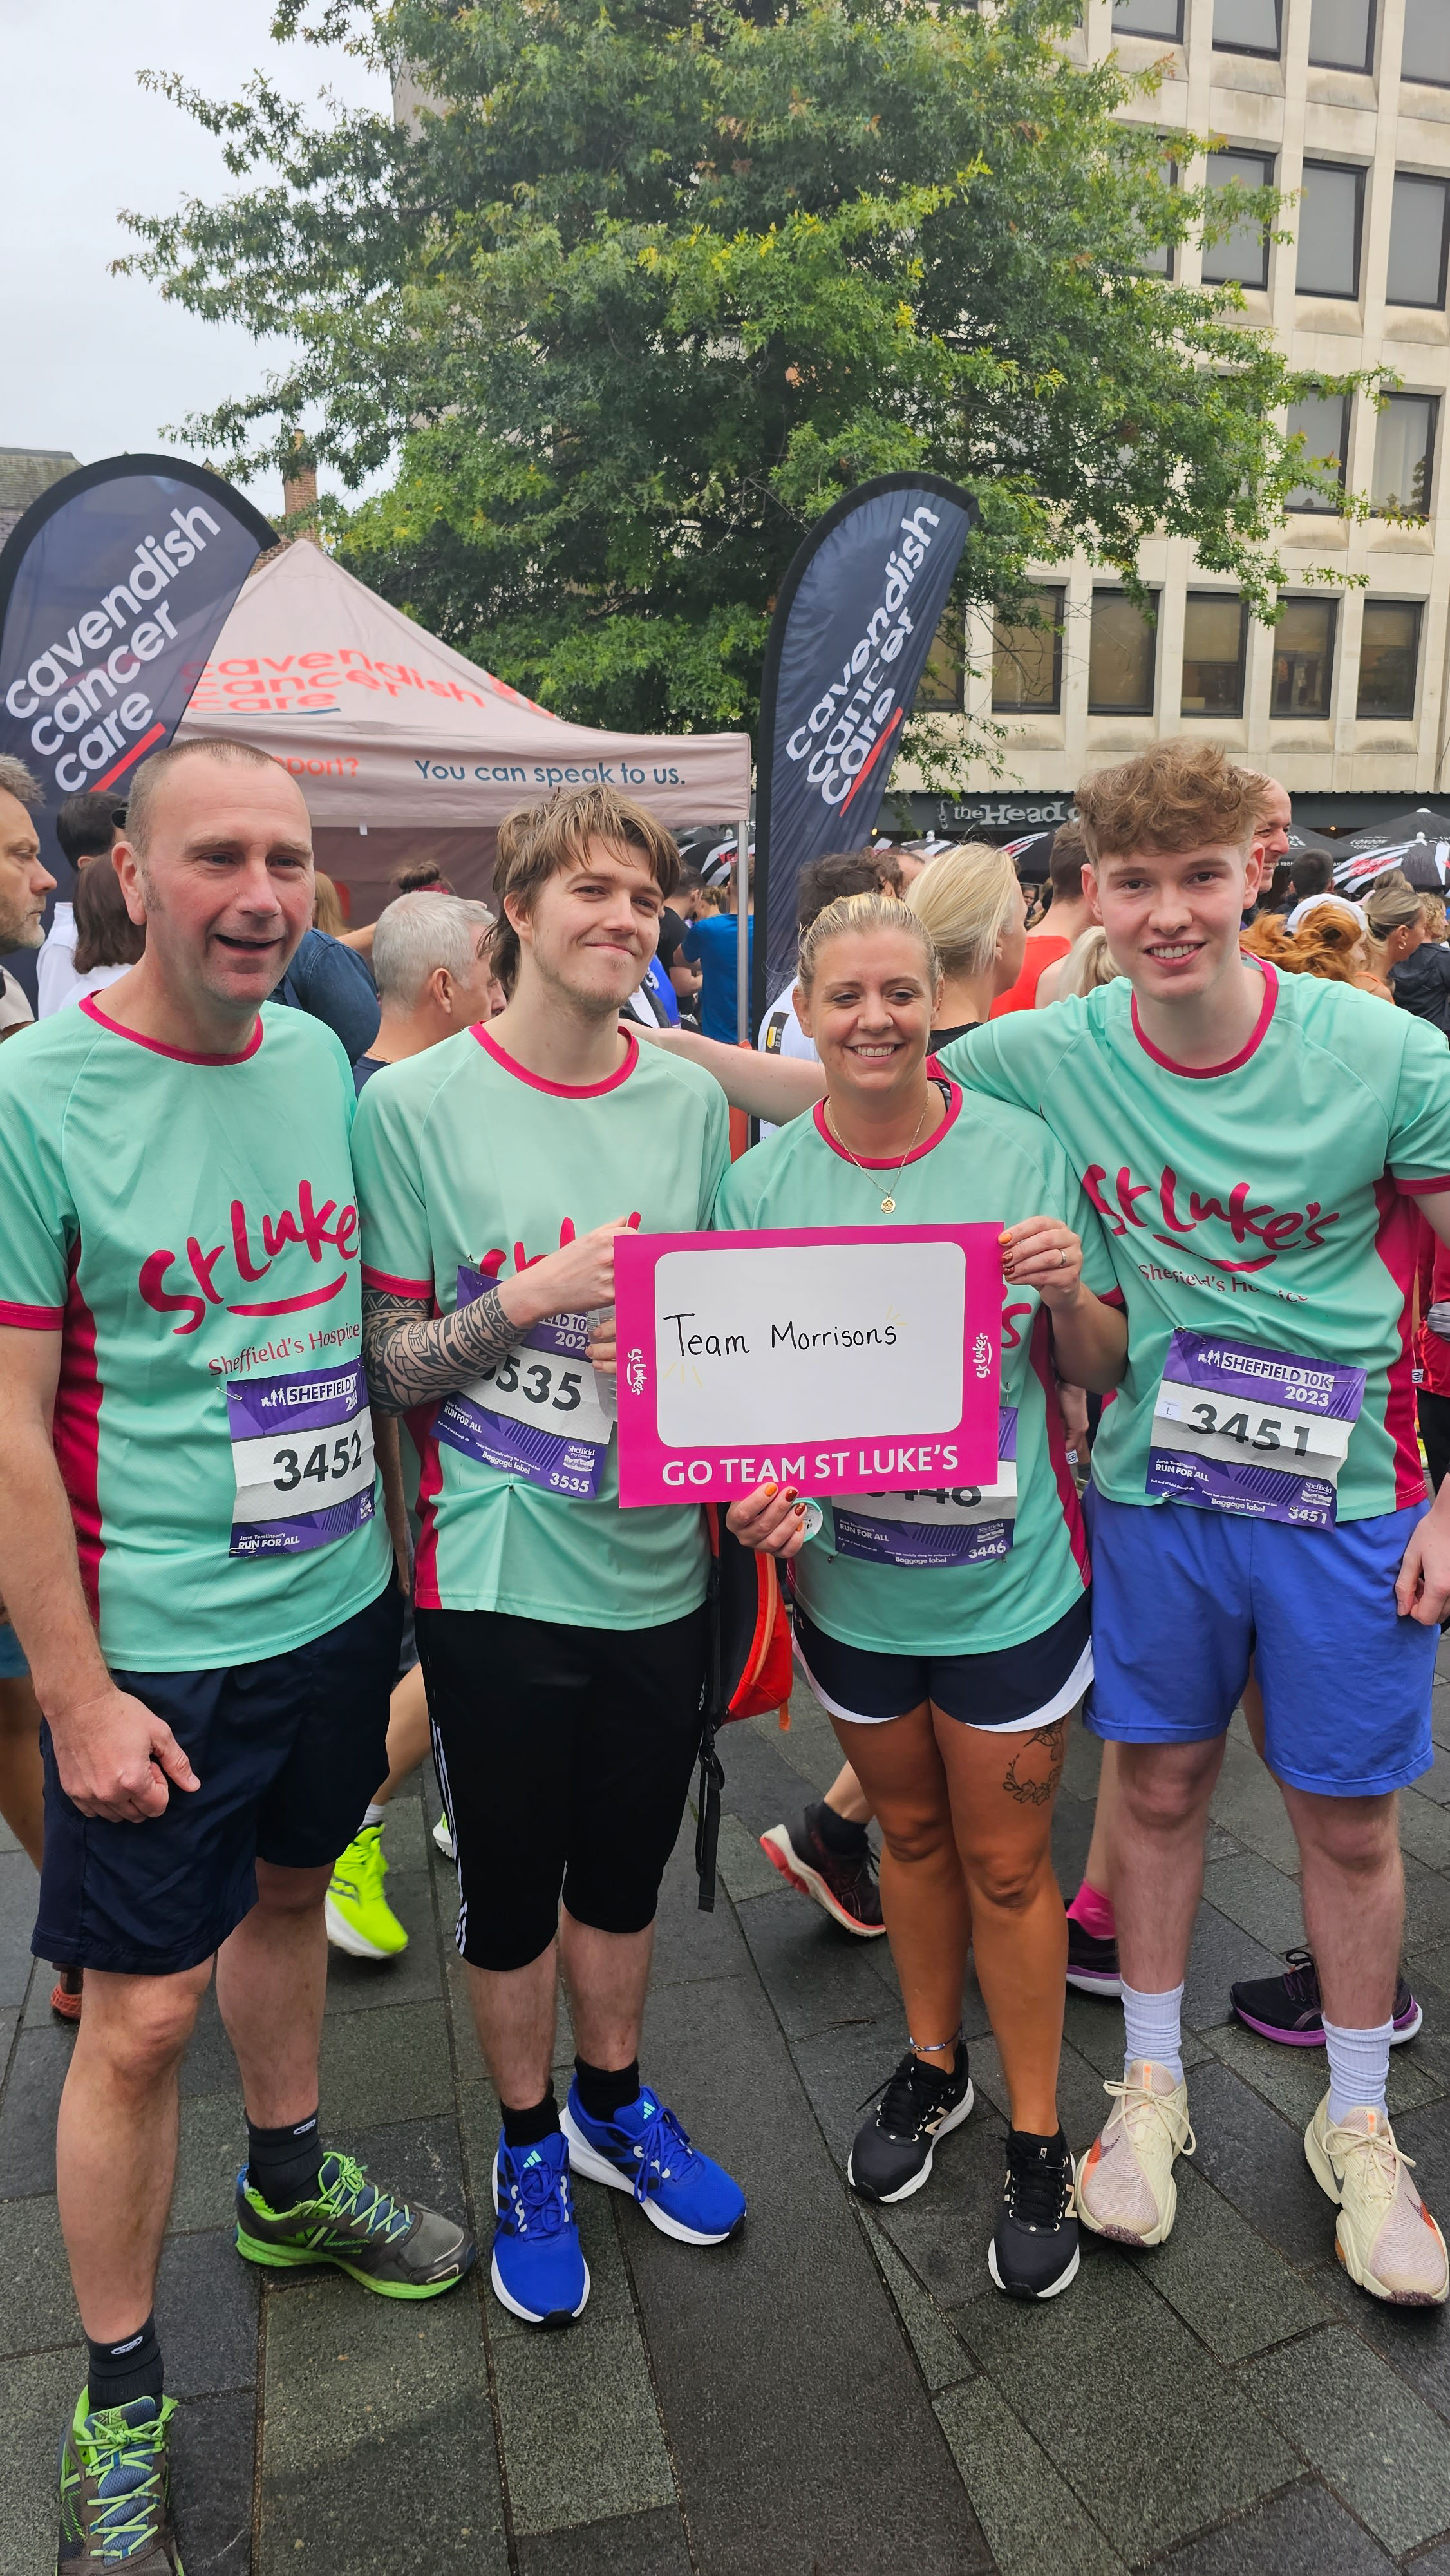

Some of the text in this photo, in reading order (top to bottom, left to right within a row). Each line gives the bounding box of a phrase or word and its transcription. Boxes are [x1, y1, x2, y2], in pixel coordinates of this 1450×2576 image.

[6, 506, 221, 718] cavendish
[786, 506, 940, 761] cavendish
[31, 600, 178, 755] cancer
[182, 648, 485, 708] cavendish
[183, 668, 400, 697] cancer
[187, 692, 337, 711] care
[807, 606, 914, 783] cancer
[55, 692, 153, 791] care
[822, 688, 896, 805] care
[414, 760, 686, 788] You can speak to us.
[954, 806, 984, 820] the
[979, 801, 1066, 825] Head
[1160, 1164, 1340, 1251] Luke's
[138, 1236, 225, 1335] St
[555, 1331, 588, 1350] 202
[663, 1312, 897, 1357] Team Morrisons
[208, 1323, 360, 1376] Sheffield's Hospice
[480, 1354, 583, 1412] 535
[1223, 1354, 1332, 1390] SHEFFIELD 10K
[290, 1379, 352, 1403] SHEFFIELD
[1284, 1385, 1330, 1408] 2023
[444, 1405, 482, 1434] RUN FOR ALL
[1187, 1403, 1310, 1457] 3451
[273, 1429, 362, 1492] 3452
[482, 1450, 531, 1475] Baggage label
[568, 1445, 596, 1456] Sheffield
[549, 1472, 590, 1493] 3535
[662, 1459, 713, 1486] GO
[719, 1455, 805, 1483] TEAM
[814, 1452, 850, 1479] ST
[1155, 1464, 1209, 1482] RUN FOR ALL
[1304, 1482, 1332, 1494] Sheffield
[1211, 1497, 1265, 1513] Baggage label
[1288, 1507, 1327, 1524] 3451
[238, 1535, 300, 1549] RUN FOR ALL
[840, 1523, 889, 1542] RUN FOR ALL
[895, 1556, 928, 1565] Baggage
[968, 1542, 1006, 1558] 3446
